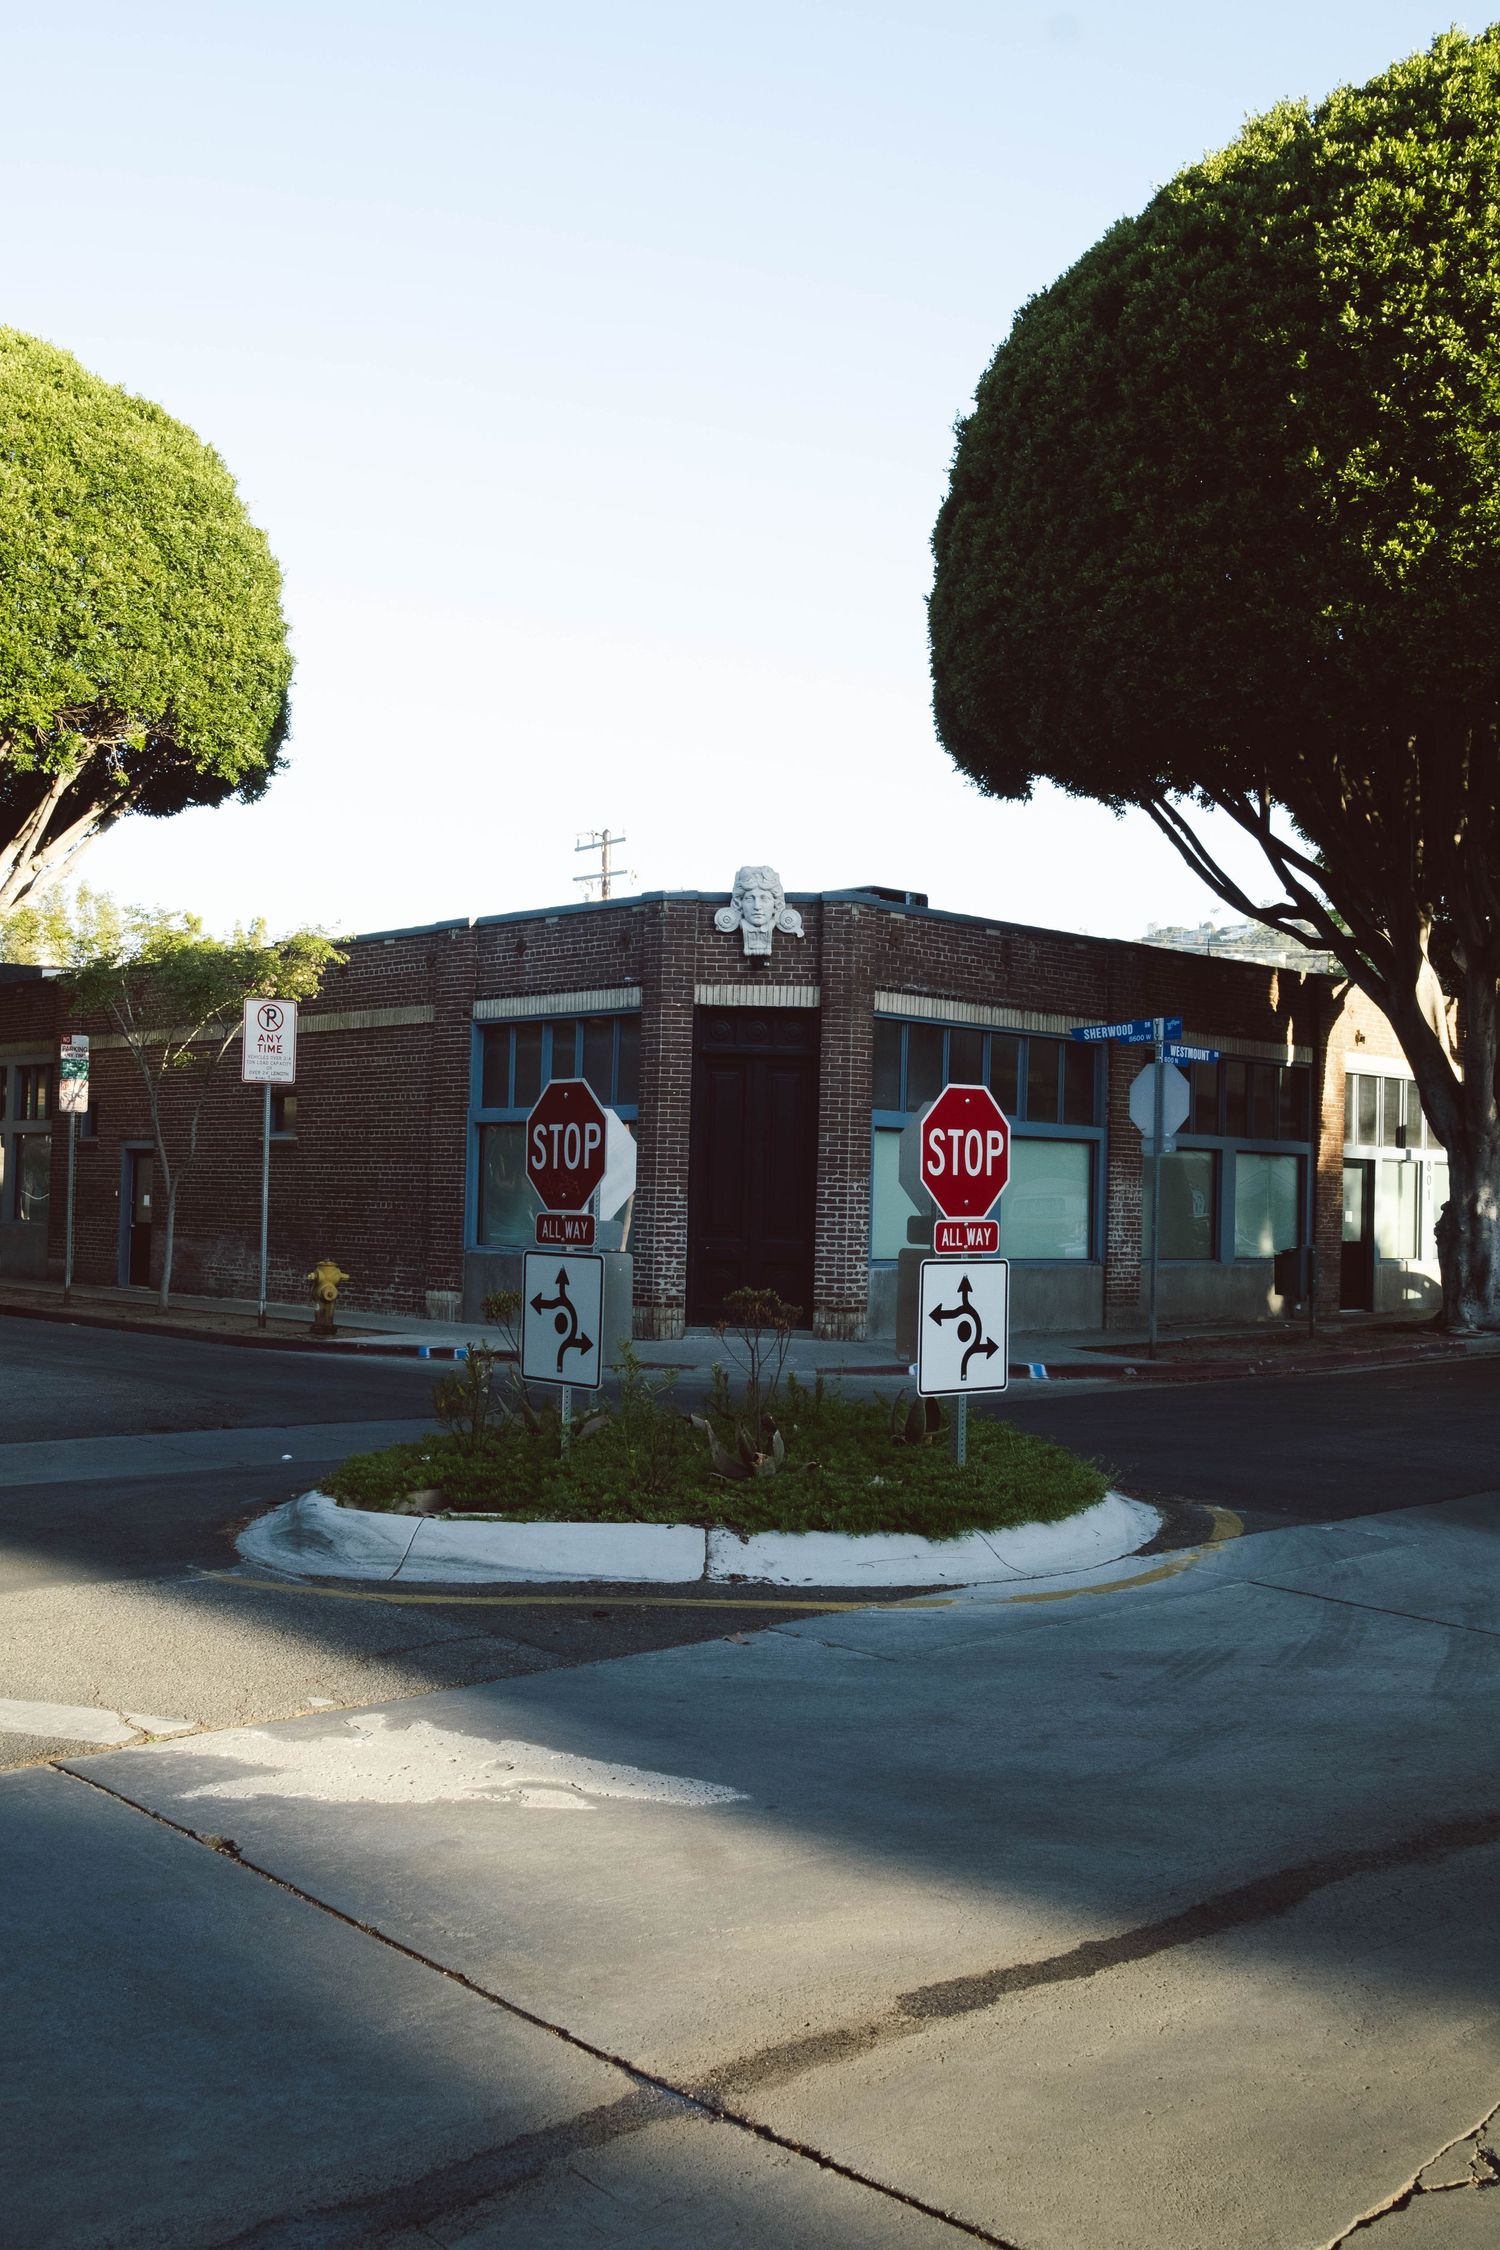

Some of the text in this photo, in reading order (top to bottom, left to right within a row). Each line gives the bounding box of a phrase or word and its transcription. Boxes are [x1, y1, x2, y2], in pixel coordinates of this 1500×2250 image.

[257, 1034, 283, 1043] ANY
[1083, 1024, 1133, 1040] SHERWOOD
[1128, 1034, 1145, 1042] 8600
[62, 1045, 88, 1053] PARKING
[257, 1044, 283, 1054] TIME
[1170, 1044, 1210, 1061] WESTMOUNT
[531, 1122, 601, 1170] STOP
[927, 1128, 1004, 1177] STOP
[541, 1220, 588, 1239] ALL WAY
[941, 1227, 992, 1247] ALL WAY
